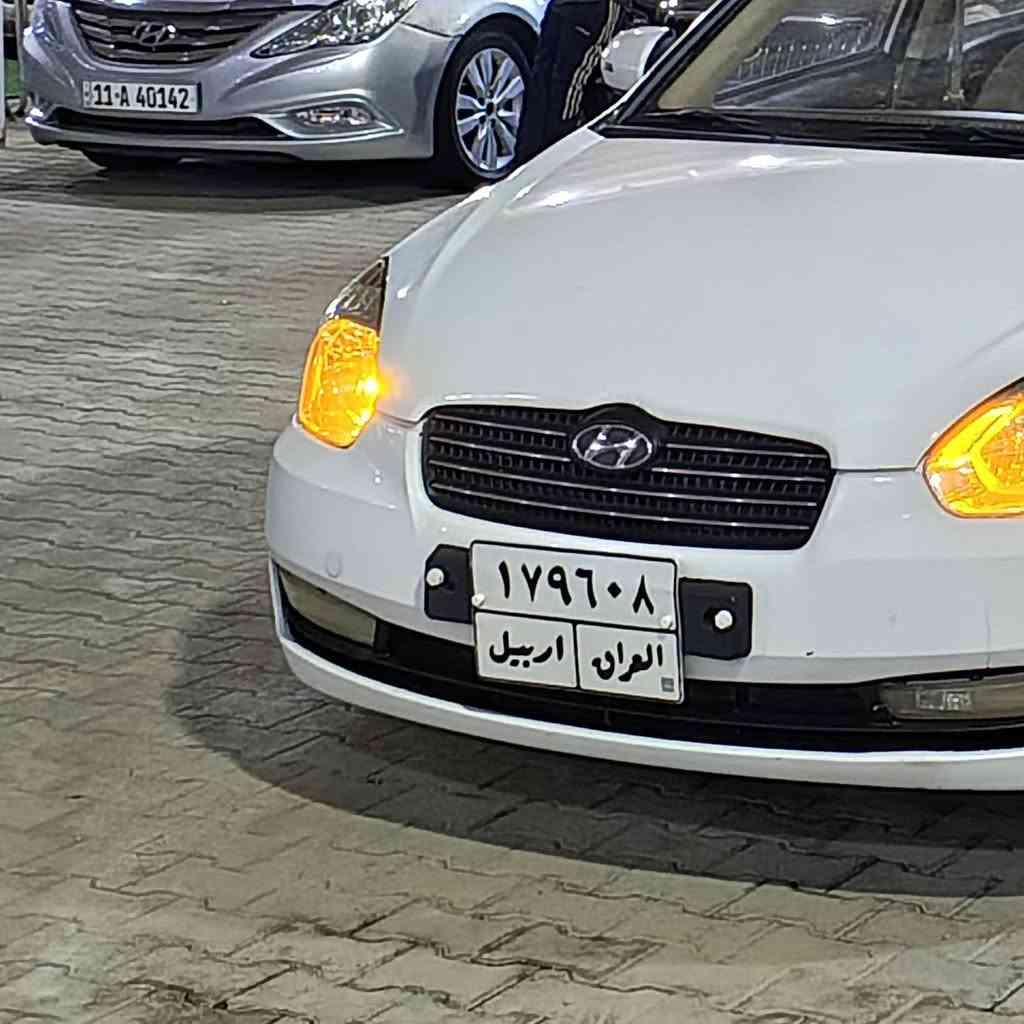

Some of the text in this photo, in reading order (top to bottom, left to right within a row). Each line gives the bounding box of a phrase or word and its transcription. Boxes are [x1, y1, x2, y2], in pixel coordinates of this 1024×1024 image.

[93, 83, 189, 110] 11 A 40142
[498, 560, 655, 616] ١٧٩٦٠٨
[489, 630, 564, 669] اربيل
